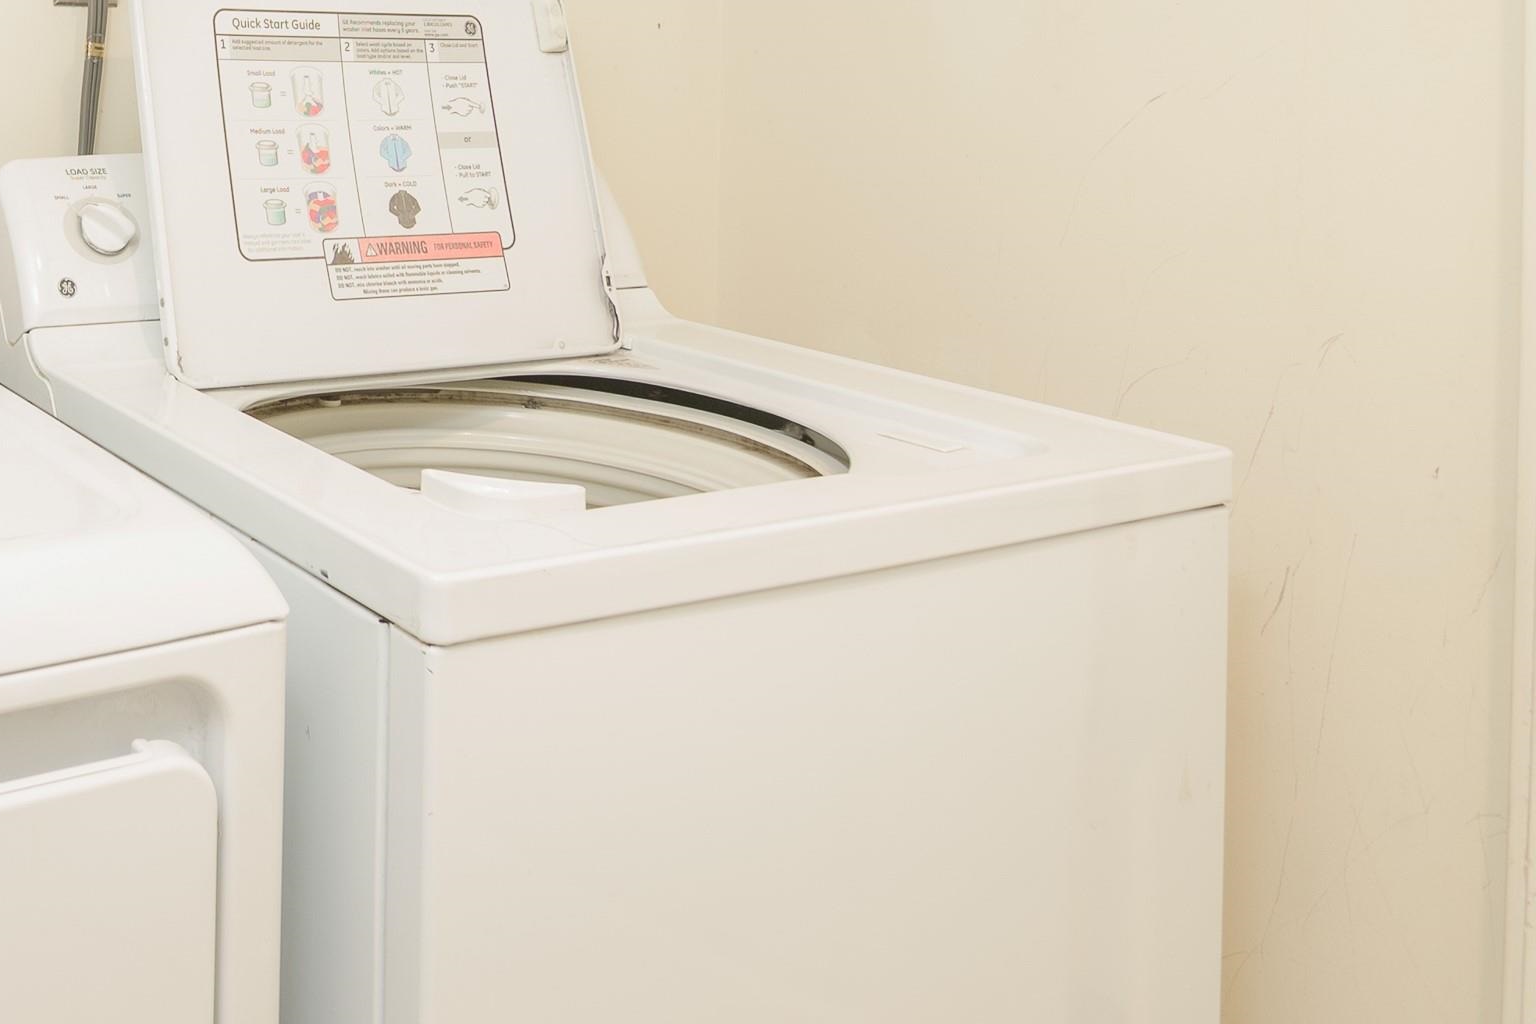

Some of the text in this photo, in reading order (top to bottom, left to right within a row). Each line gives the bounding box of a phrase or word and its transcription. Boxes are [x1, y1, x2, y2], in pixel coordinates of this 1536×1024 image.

[231, 17, 321, 30] Quick Start Guide
[220, 39, 226, 49] 1
[344, 41, 350, 52] 2
[428, 43, 435, 53] 3
[65, 167, 108, 176] LOAD SIZE
[376, 240, 429, 255] WARNING
[434, 243, 444, 251] FOR
[445, 242, 473, 250] PERSONAL
